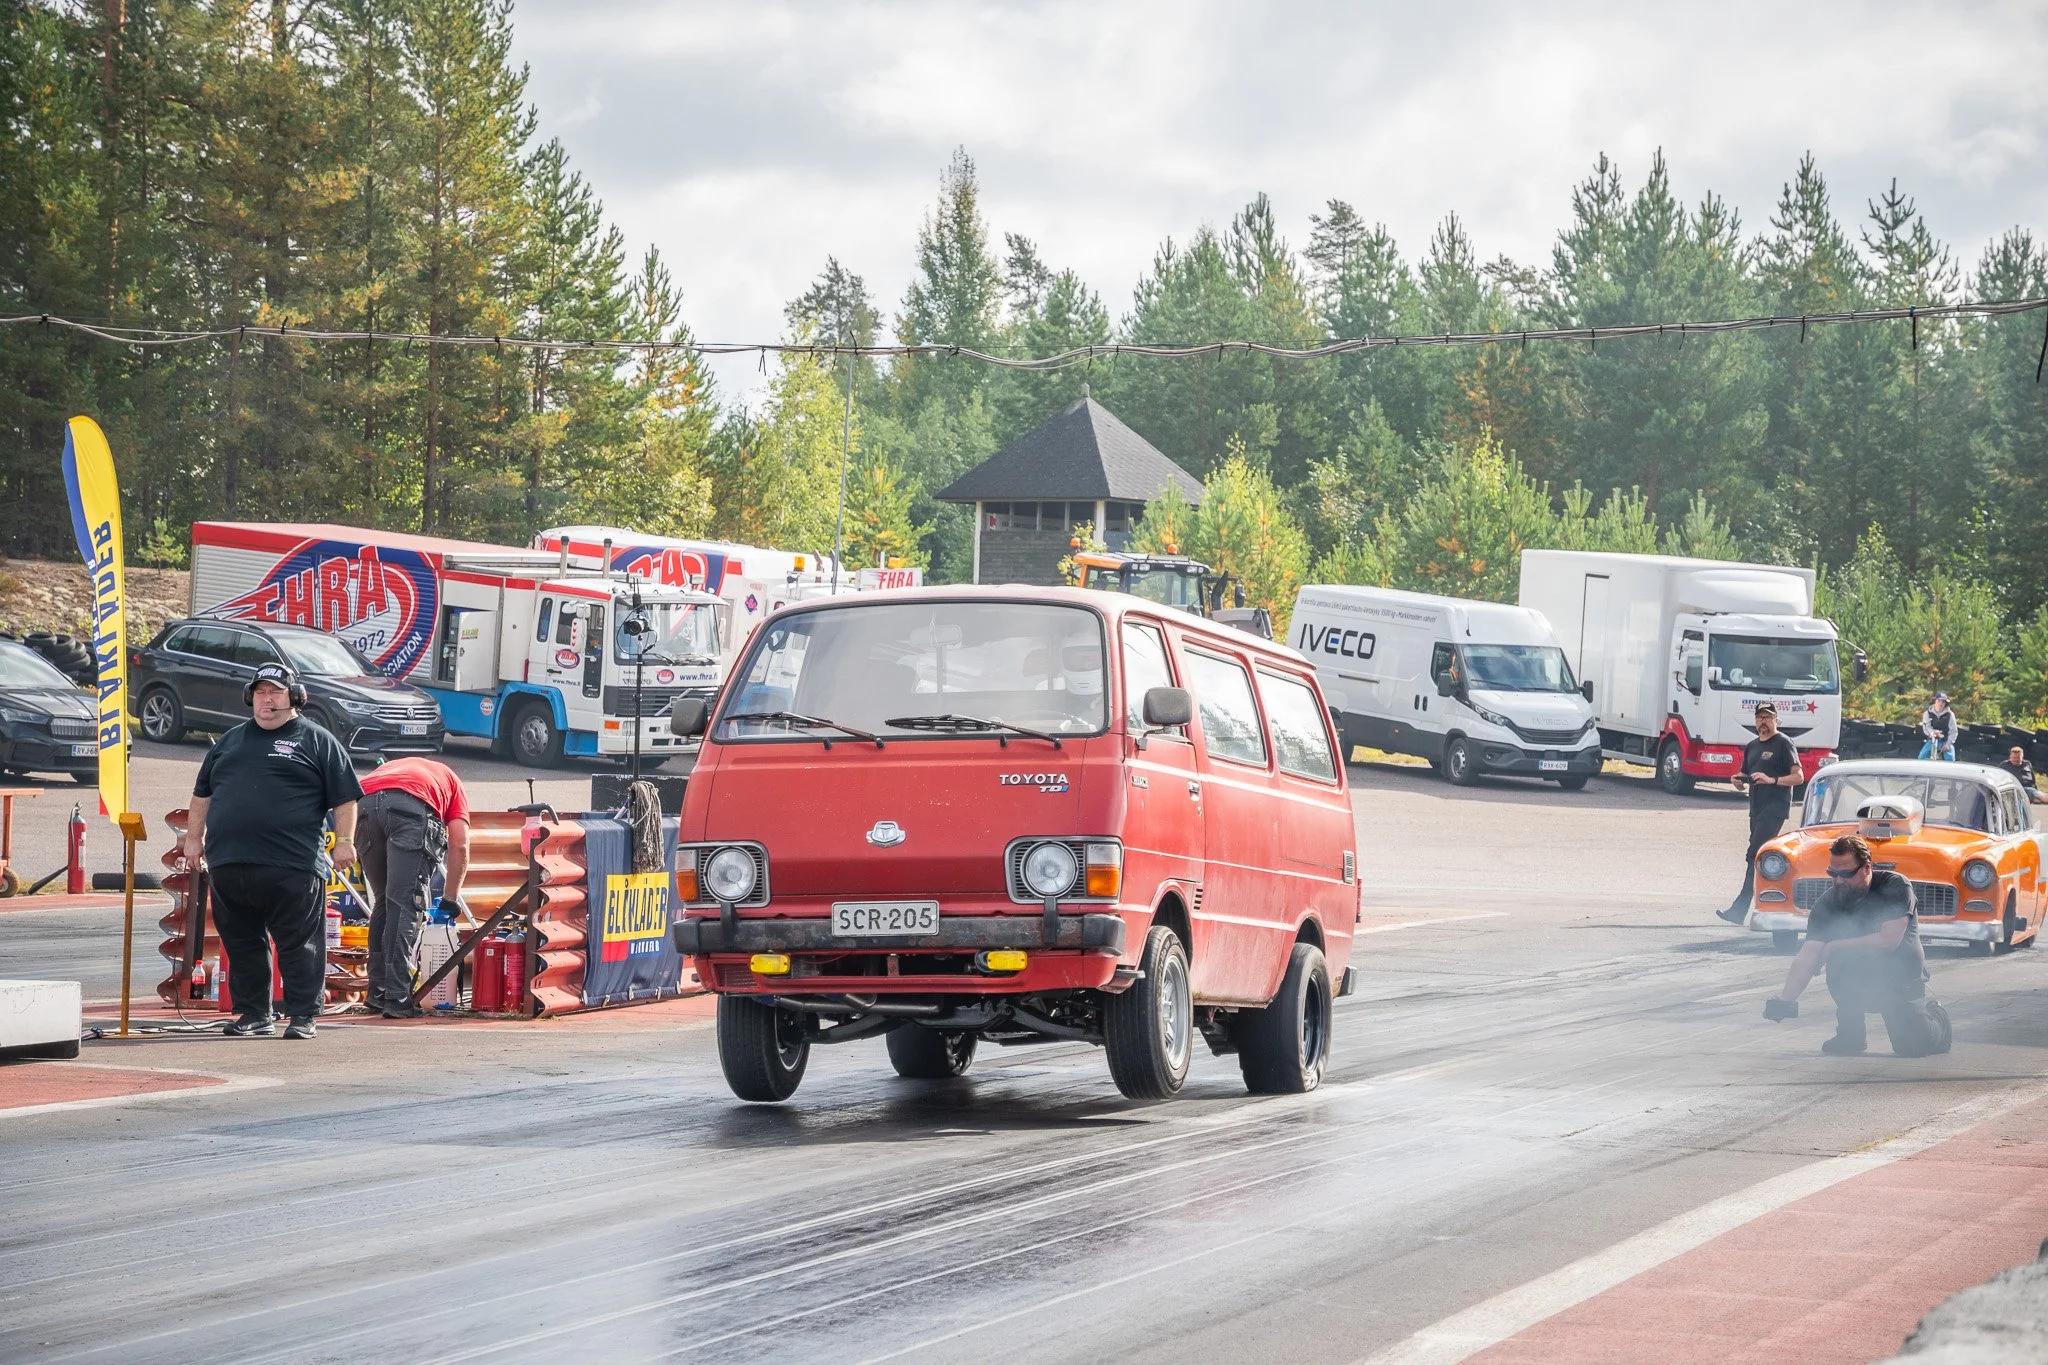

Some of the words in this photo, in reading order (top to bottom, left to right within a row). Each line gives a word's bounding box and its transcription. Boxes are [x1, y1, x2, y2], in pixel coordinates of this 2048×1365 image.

[878, 571, 913, 589] FHRA
[1299, 623, 1376, 659] IVECO
[680, 673, 718, 681] www.fhra.fi
[274, 740, 299, 748] CREW
[999, 774, 1068, 784] TOYOTA
[840, 908, 932, 930] SCR-205
